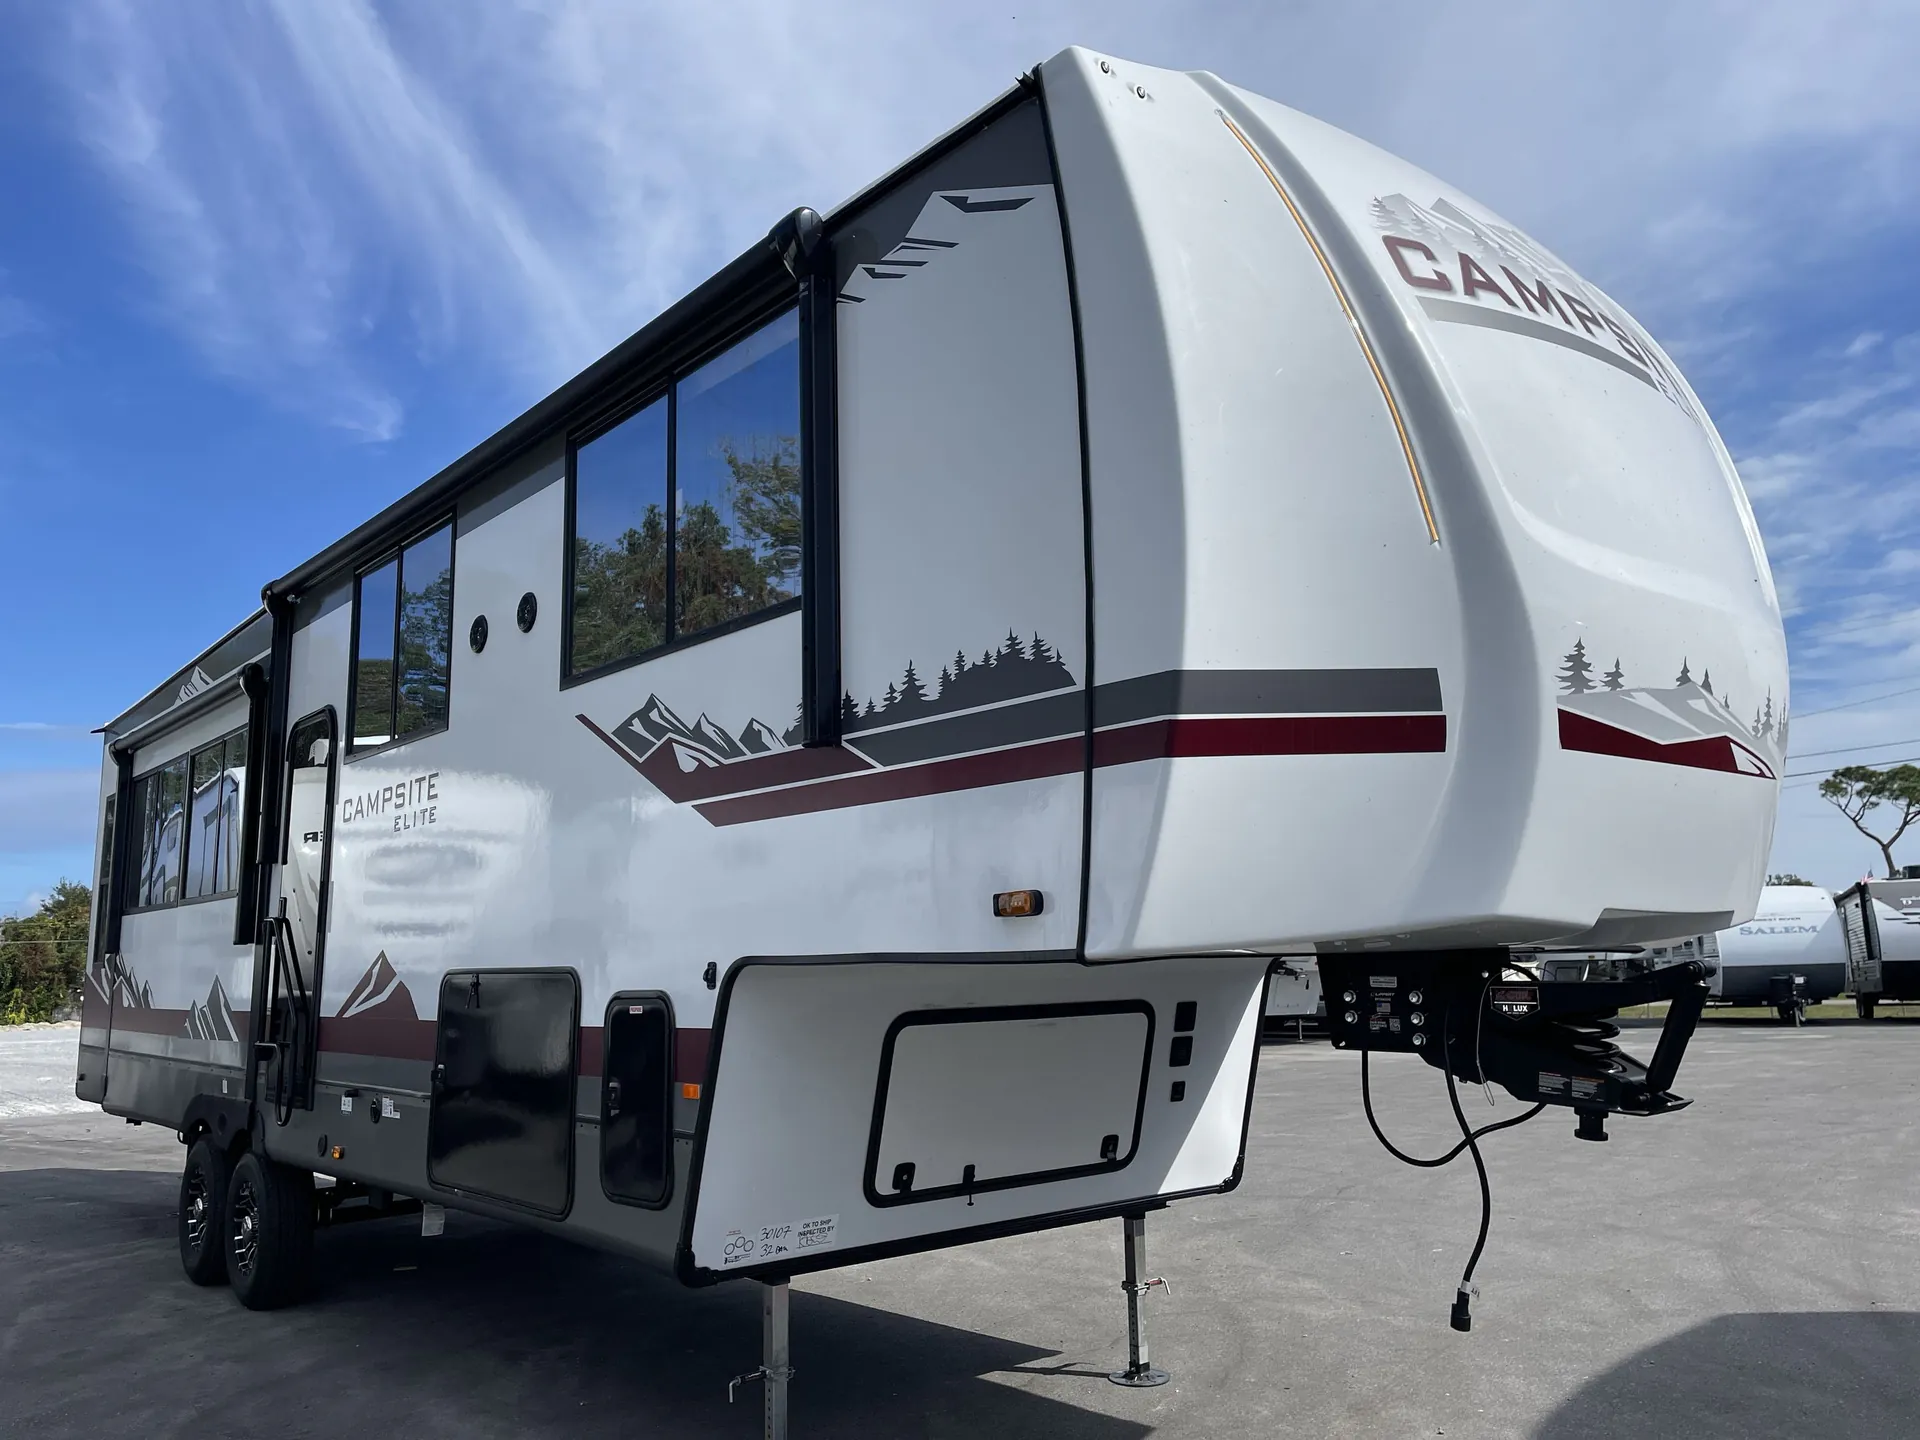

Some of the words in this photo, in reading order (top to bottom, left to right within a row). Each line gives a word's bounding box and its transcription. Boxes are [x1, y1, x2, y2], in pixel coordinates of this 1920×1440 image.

[342, 772, 440, 823] CAMPSITE
[393, 806, 437, 832] ELITE
[1739, 925, 1819, 936] SALEM
[1502, 1004, 1528, 1012] HLUX
[820, 1218, 832, 1226] SHIP
[760, 1225, 792, 1242] 30107
[797, 1227, 827, 1237] INSPECTED
